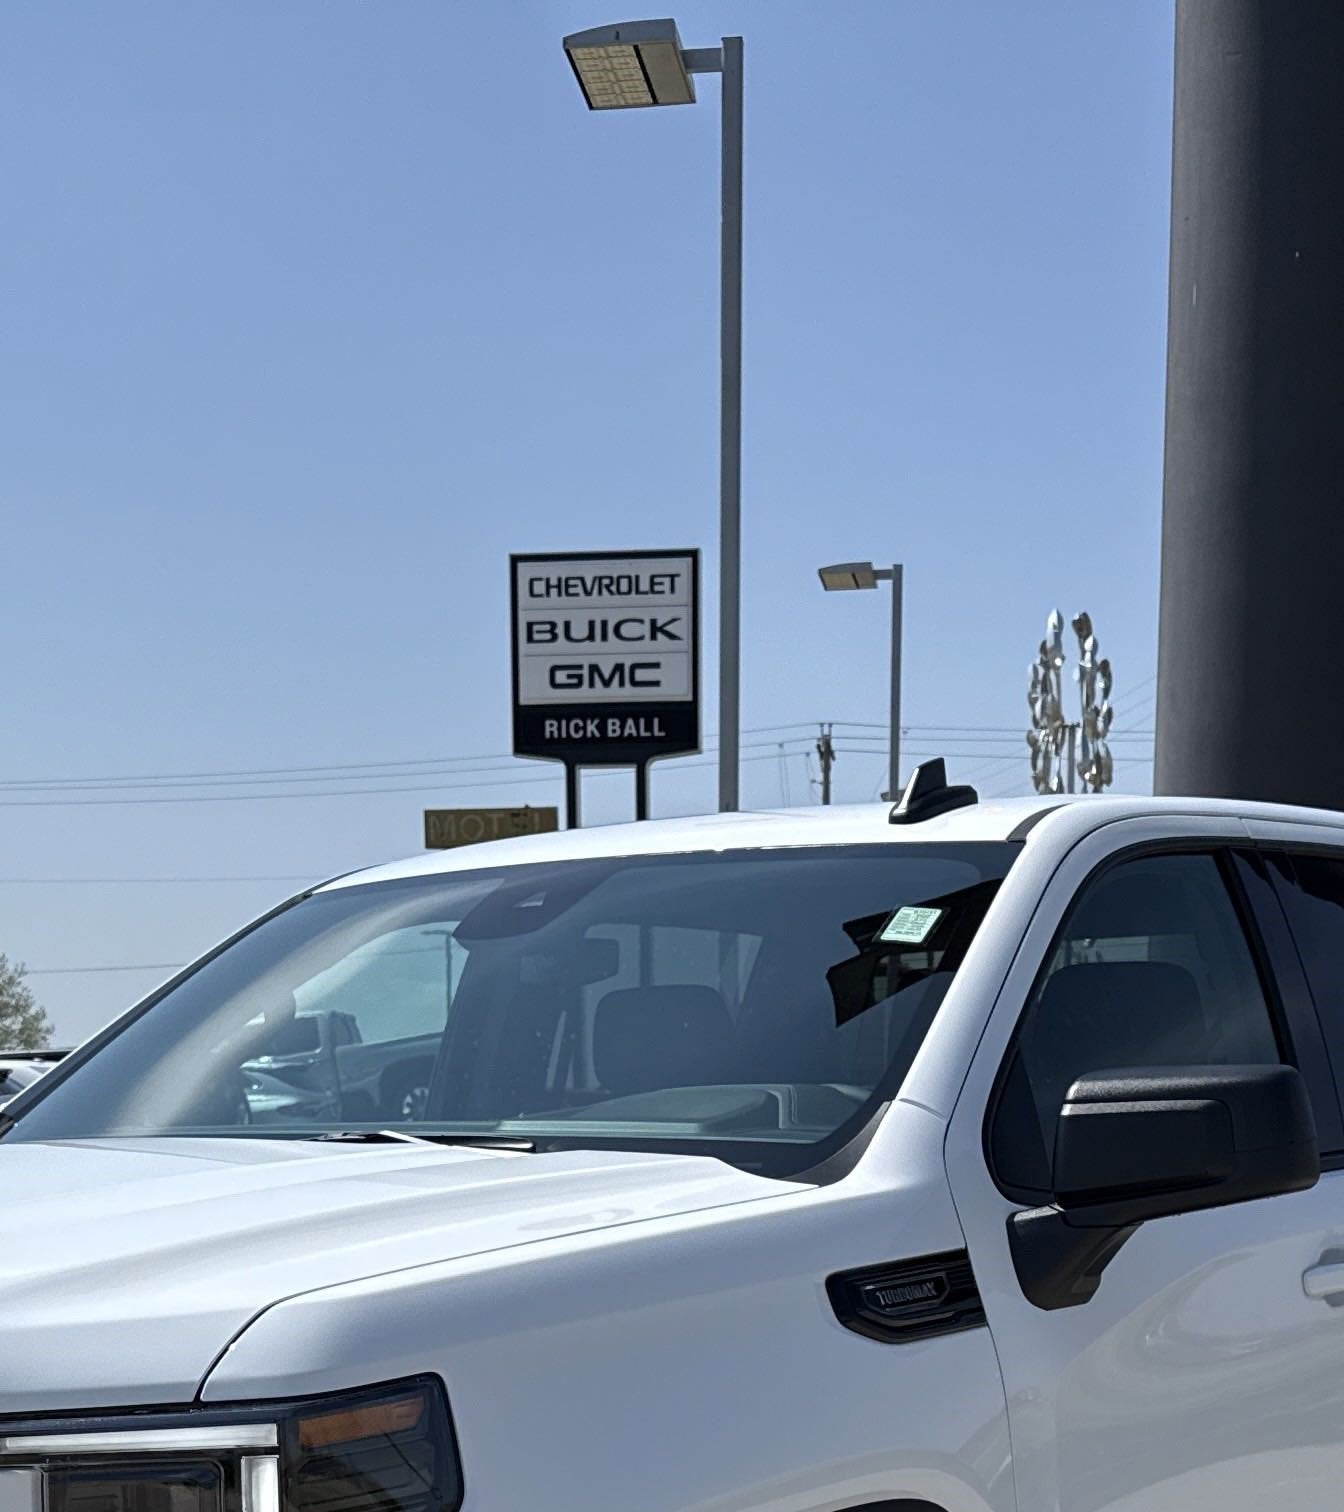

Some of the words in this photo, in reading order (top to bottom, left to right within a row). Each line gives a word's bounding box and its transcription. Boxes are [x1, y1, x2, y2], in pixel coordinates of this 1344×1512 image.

[528, 573, 681, 598] CHEVROLET
[526, 617, 683, 644] BUICK
[549, 661, 662, 690] GMC
[545, 718, 601, 739] RICK
[607, 717, 666, 738] BALL
